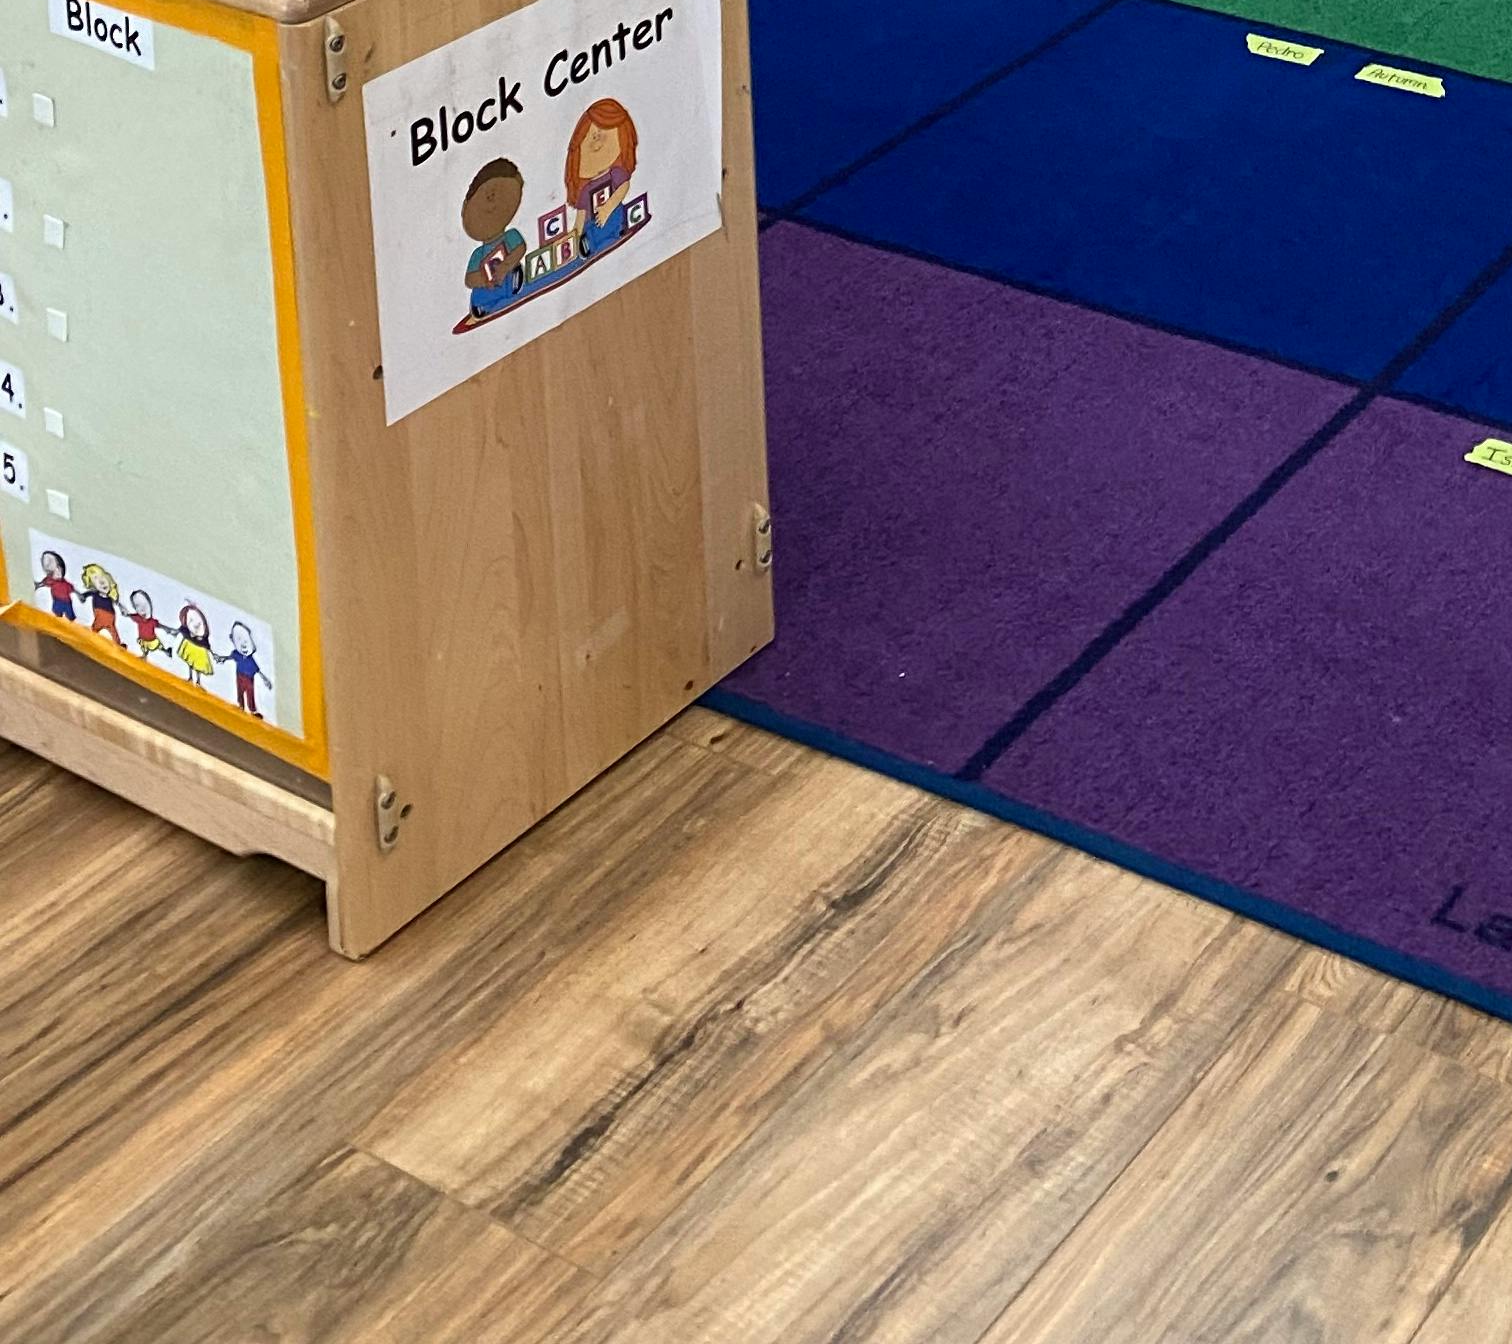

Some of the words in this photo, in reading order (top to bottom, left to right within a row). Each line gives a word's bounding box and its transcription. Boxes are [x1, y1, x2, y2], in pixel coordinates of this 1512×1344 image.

[1257, 41, 1305, 60] Pedro
[410, 76, 525, 167] Block
[543, 6, 675, 99] Center
[3, 454, 26, 491] 5.
